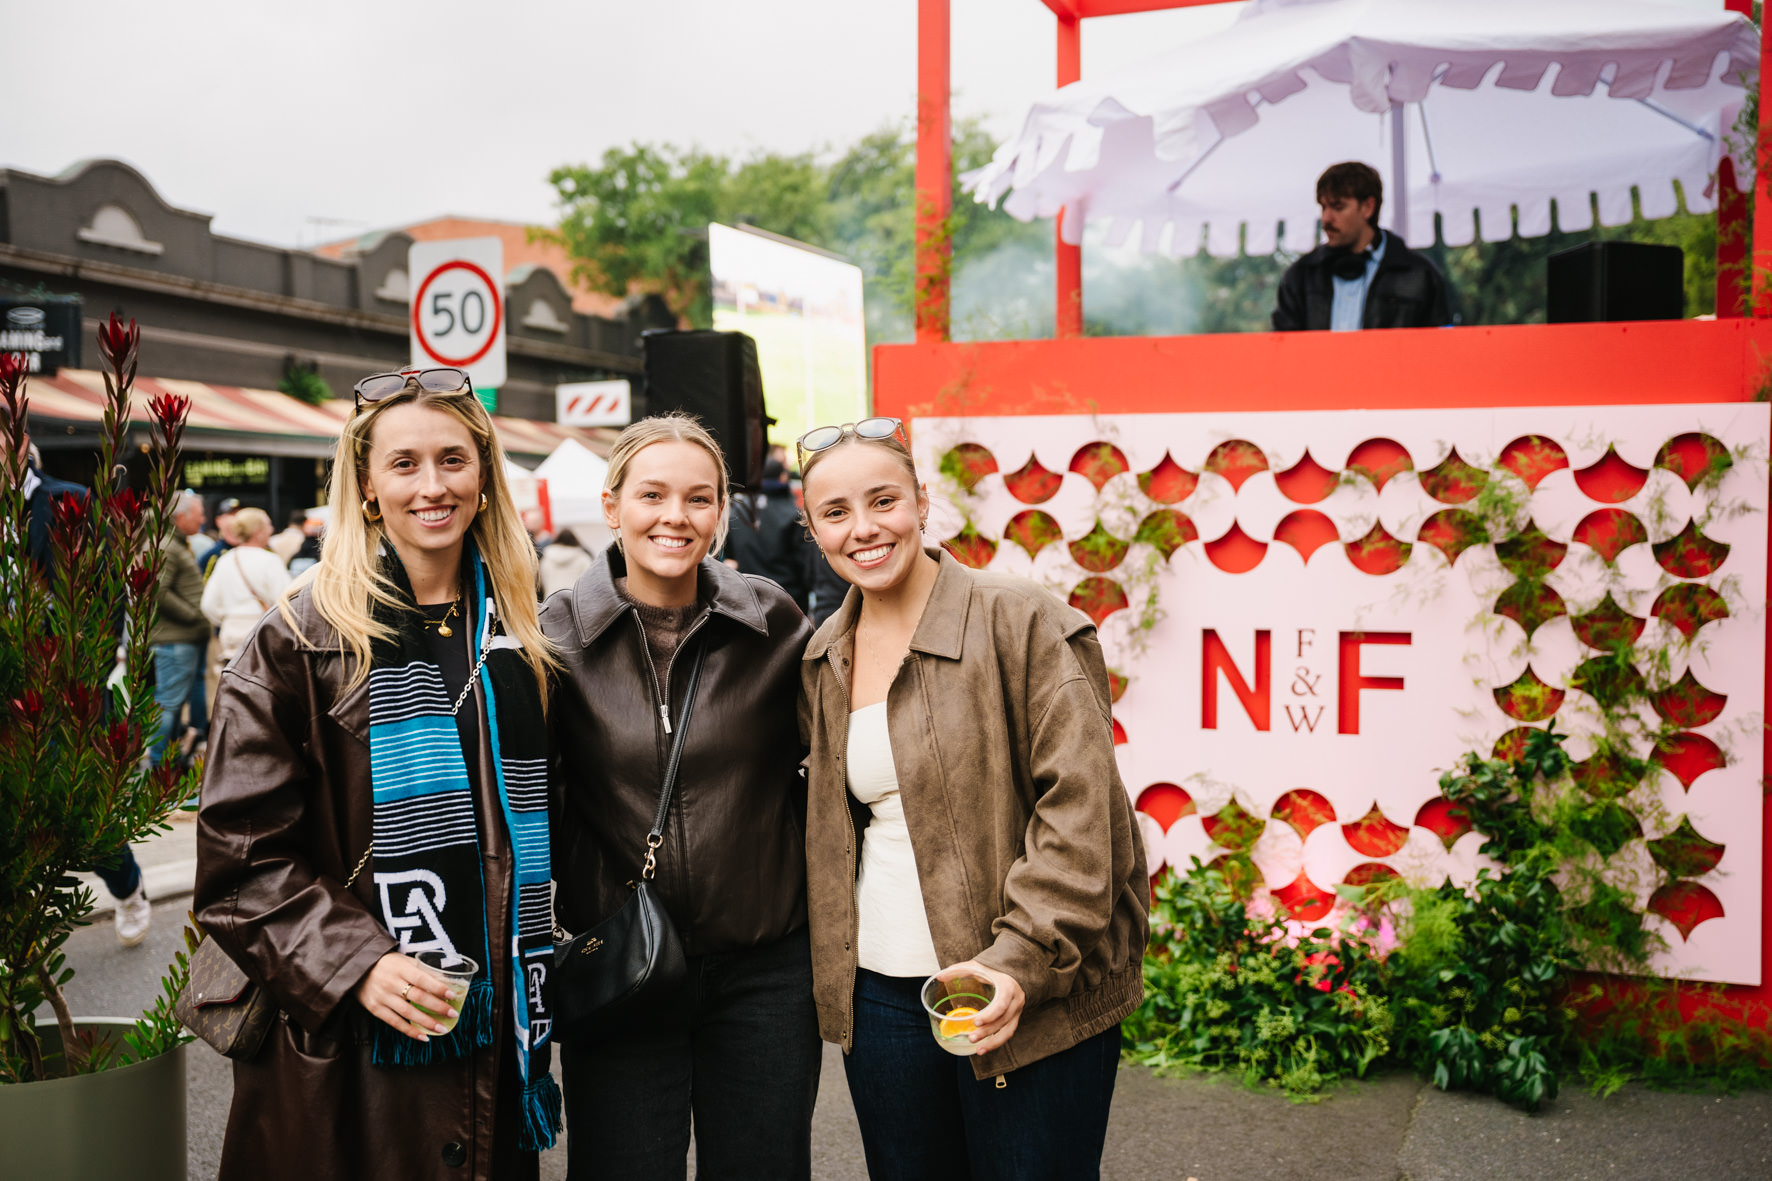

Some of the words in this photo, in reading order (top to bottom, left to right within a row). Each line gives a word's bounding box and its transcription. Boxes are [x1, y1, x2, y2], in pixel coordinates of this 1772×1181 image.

[433, 291, 484, 336] 50
[0, 329, 45, 352] AMING
[1296, 628, 1316, 658] F
[1201, 628, 1271, 732] N
[1338, 631, 1412, 735] F
[1291, 666, 1321, 697] &
[1284, 704, 1325, 733] W
